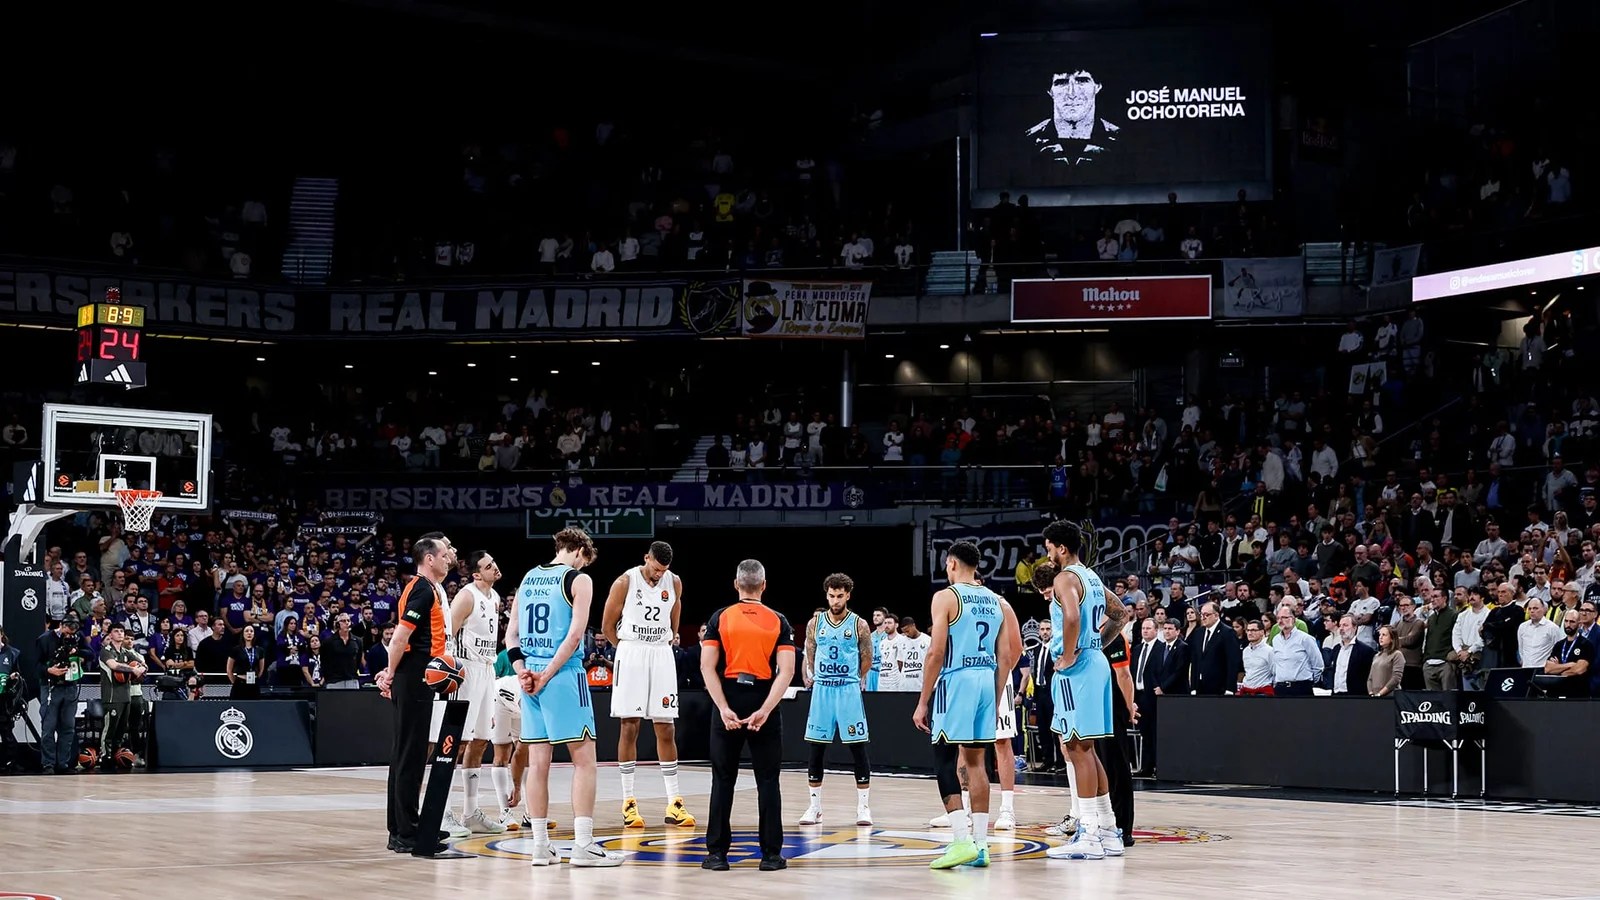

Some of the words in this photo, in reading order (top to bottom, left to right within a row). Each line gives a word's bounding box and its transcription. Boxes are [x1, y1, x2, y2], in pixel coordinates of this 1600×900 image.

[1126, 86, 1170, 105] JOSÉ
[1174, 86, 1246, 103] MANUEL
[1126, 104, 1246, 121] OCHOTORENA
[812, 290, 866, 301] MADRIDISTA
[1082, 286, 1140, 302] Mahou
[330, 290, 456, 332] REAL
[474, 287, 674, 330] MADRID
[782, 300, 802, 320] LA
[816, 300, 866, 323] COMA
[100, 328, 140, 360] 24
[324, 486, 544, 510] BERSERKERS
[588, 484, 679, 508] REAL
[704, 484, 832, 508] MADRID
[565, 520, 614, 534] EXIT
[525, 602, 550, 634] 18
[644, 606, 662, 622] 22
[978, 607, 996, 616] MSC
[489, 618, 494, 634] 6
[976, 621, 990, 652] 2
[828, 646, 838, 660] 3
[907, 651, 918, 660] 20
[819, 662, 850, 674] beko
[904, 660, 923, 669] beko
[821, 678, 847, 688] misli
[999, 714, 1011, 730] 14
[1400, 710, 1452, 725] SPALDING
[1458, 712, 1485, 724] SPALDING
[856, 721, 866, 736] 3
